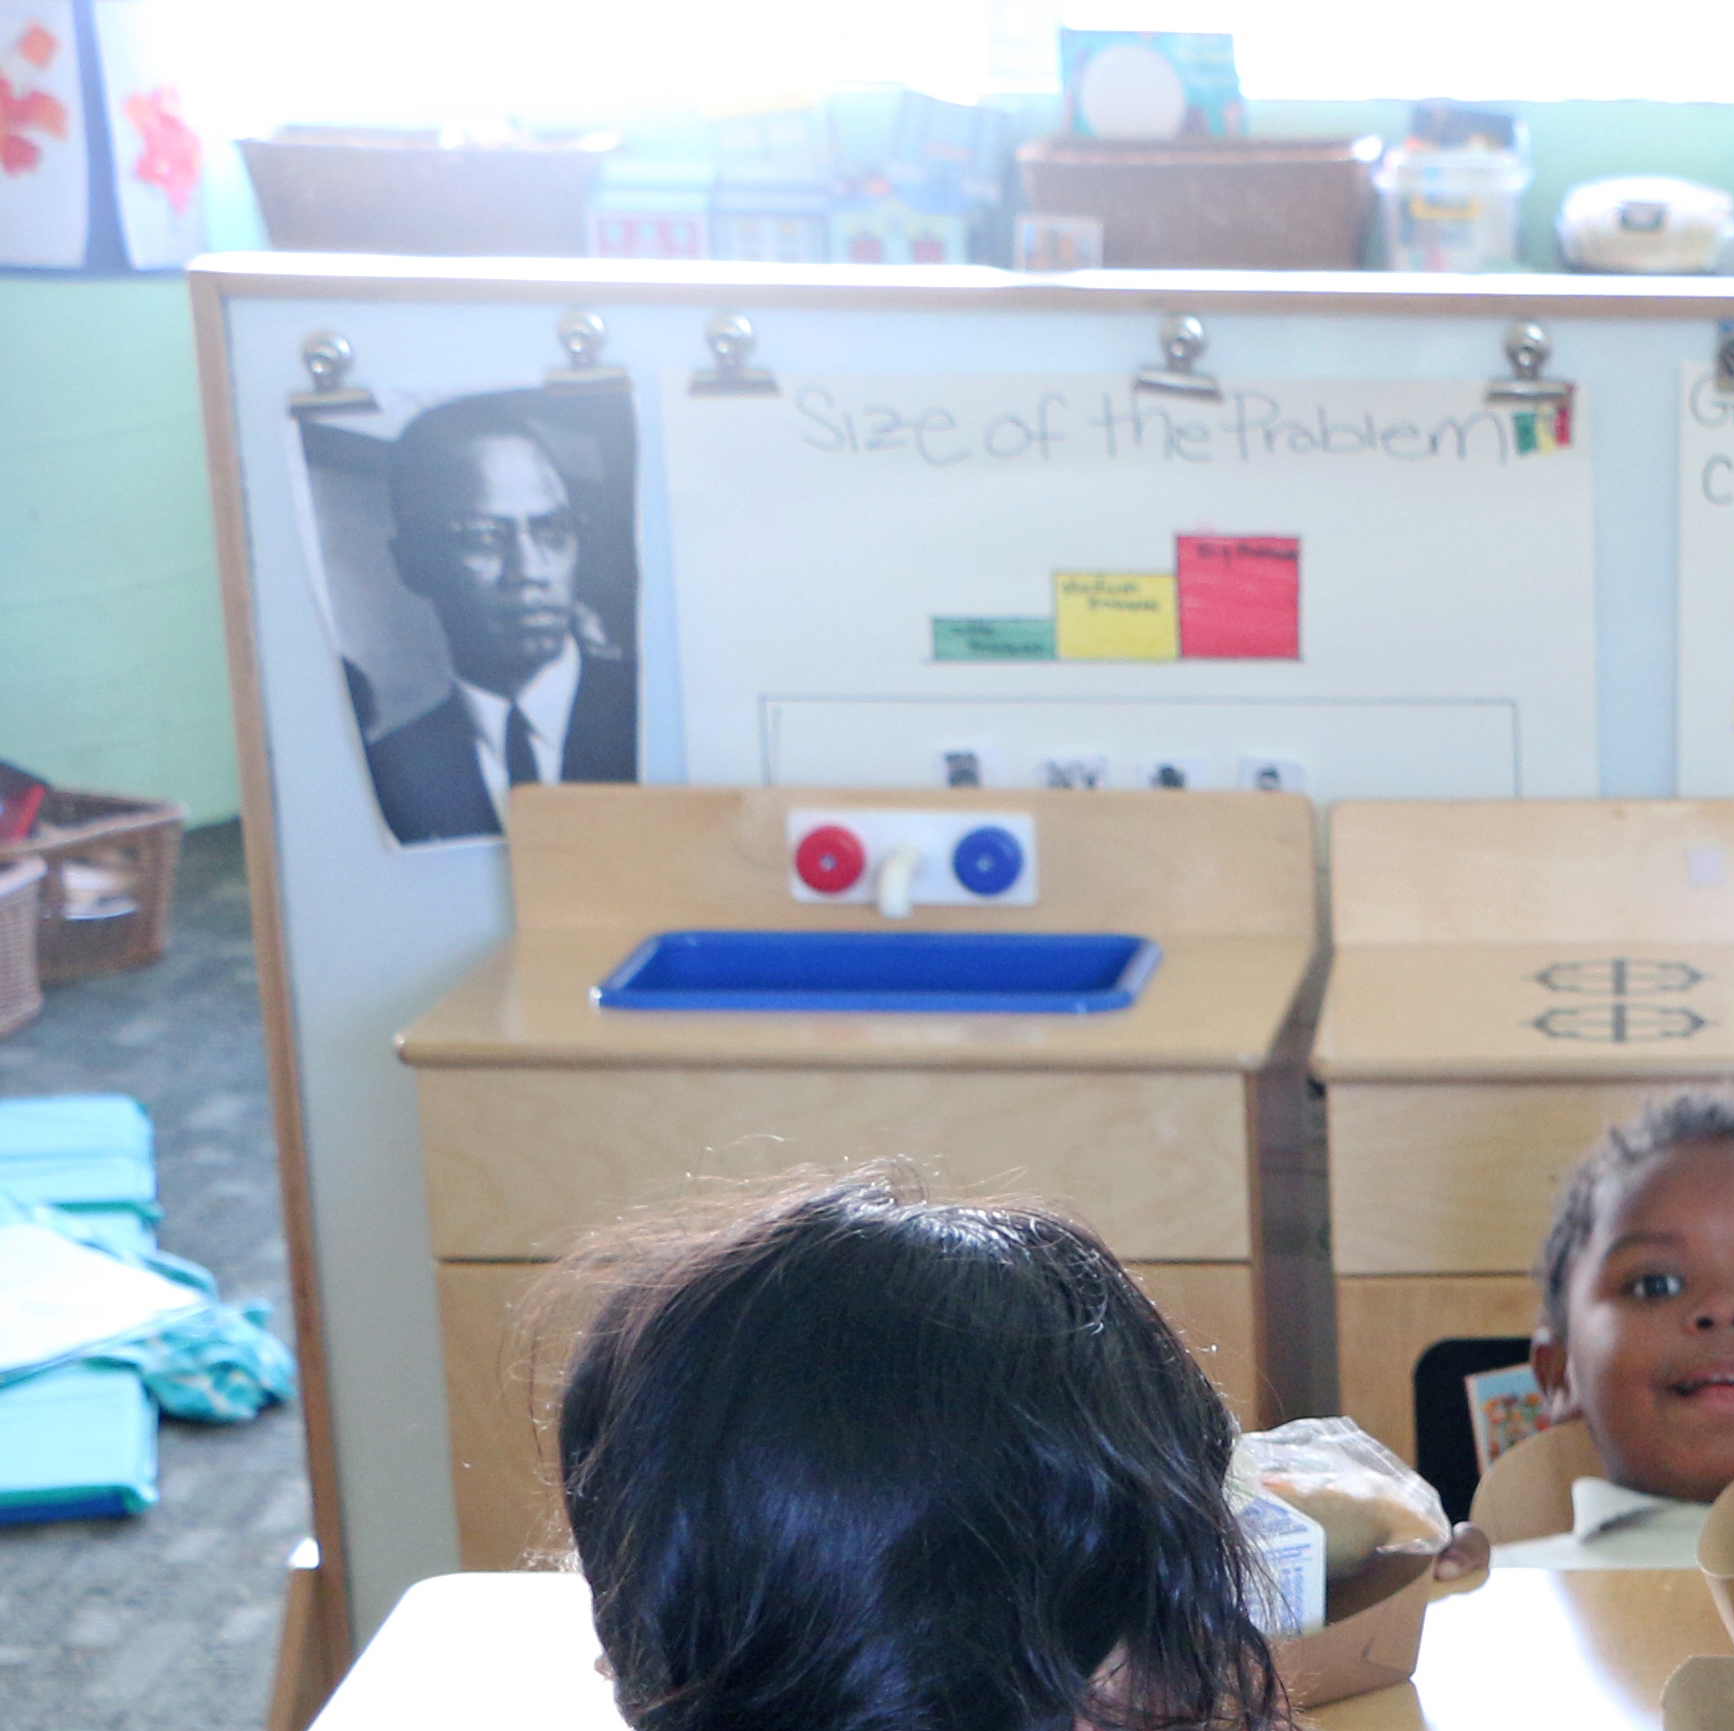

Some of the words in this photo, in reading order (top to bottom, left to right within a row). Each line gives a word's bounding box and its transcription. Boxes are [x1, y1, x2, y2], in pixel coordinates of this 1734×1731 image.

[796, 391, 964, 467] Size
[983, 398, 1069, 462] of
[1095, 400, 1212, 464] the
[1230, 399, 1510, 464] Problem
